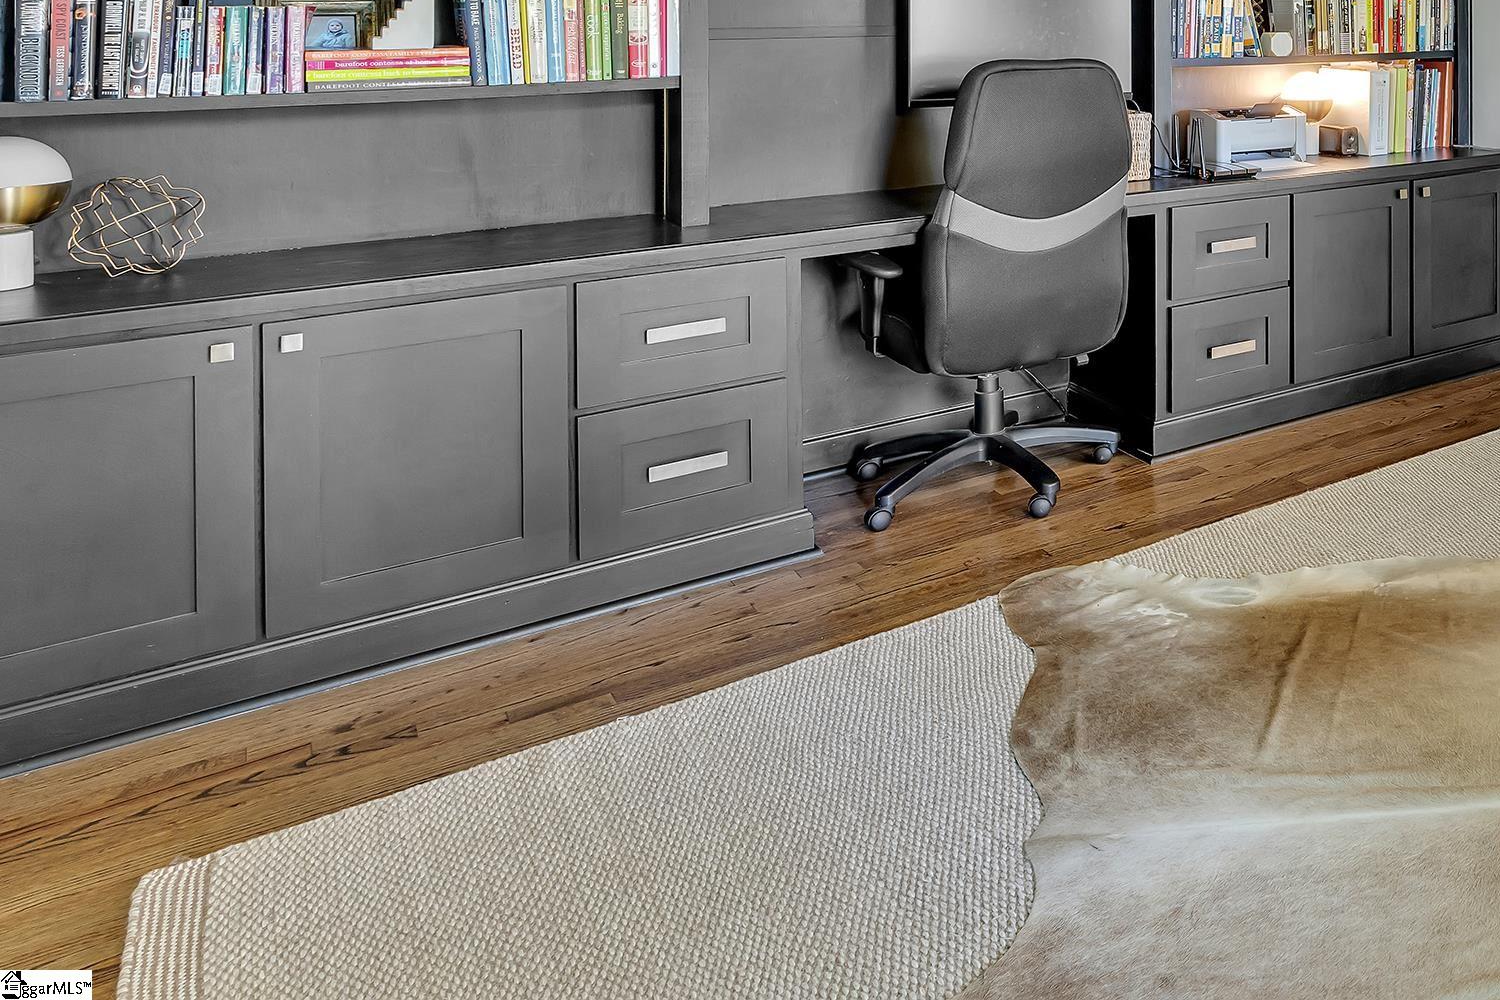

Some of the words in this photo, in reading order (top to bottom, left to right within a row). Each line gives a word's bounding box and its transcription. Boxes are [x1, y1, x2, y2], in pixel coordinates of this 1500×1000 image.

[56, 3, 67, 16] SPY
[105, 1, 124, 33] CORNWELL
[470, 1, 479, 9] TO
[21, 2, 43, 35] CORNWELL
[56, 18, 66, 41] COAST
[471, 10, 480, 25] BAKE
[587, 14, 600, 39] cook
[615, 13, 624, 34] Baking
[20, 38, 40, 64] BLACK
[56, 45, 65, 58] TESS
[104, 34, 122, 45] THE
[510, 28, 522, 69] BREAD
[103, 46, 121, 60] LAST
[150, 37, 158, 70] FAHRENHEIT
[335, 60, 368, 68] barefoot
[474, 41, 482, 73] HOLLYWOOD
[19, 67, 40, 95] NOTICE
[55, 59, 65, 86] GERRITSEN
[102, 60, 120, 90] PRECINCT
[315, 82, 360, 90] BAREFOOT
